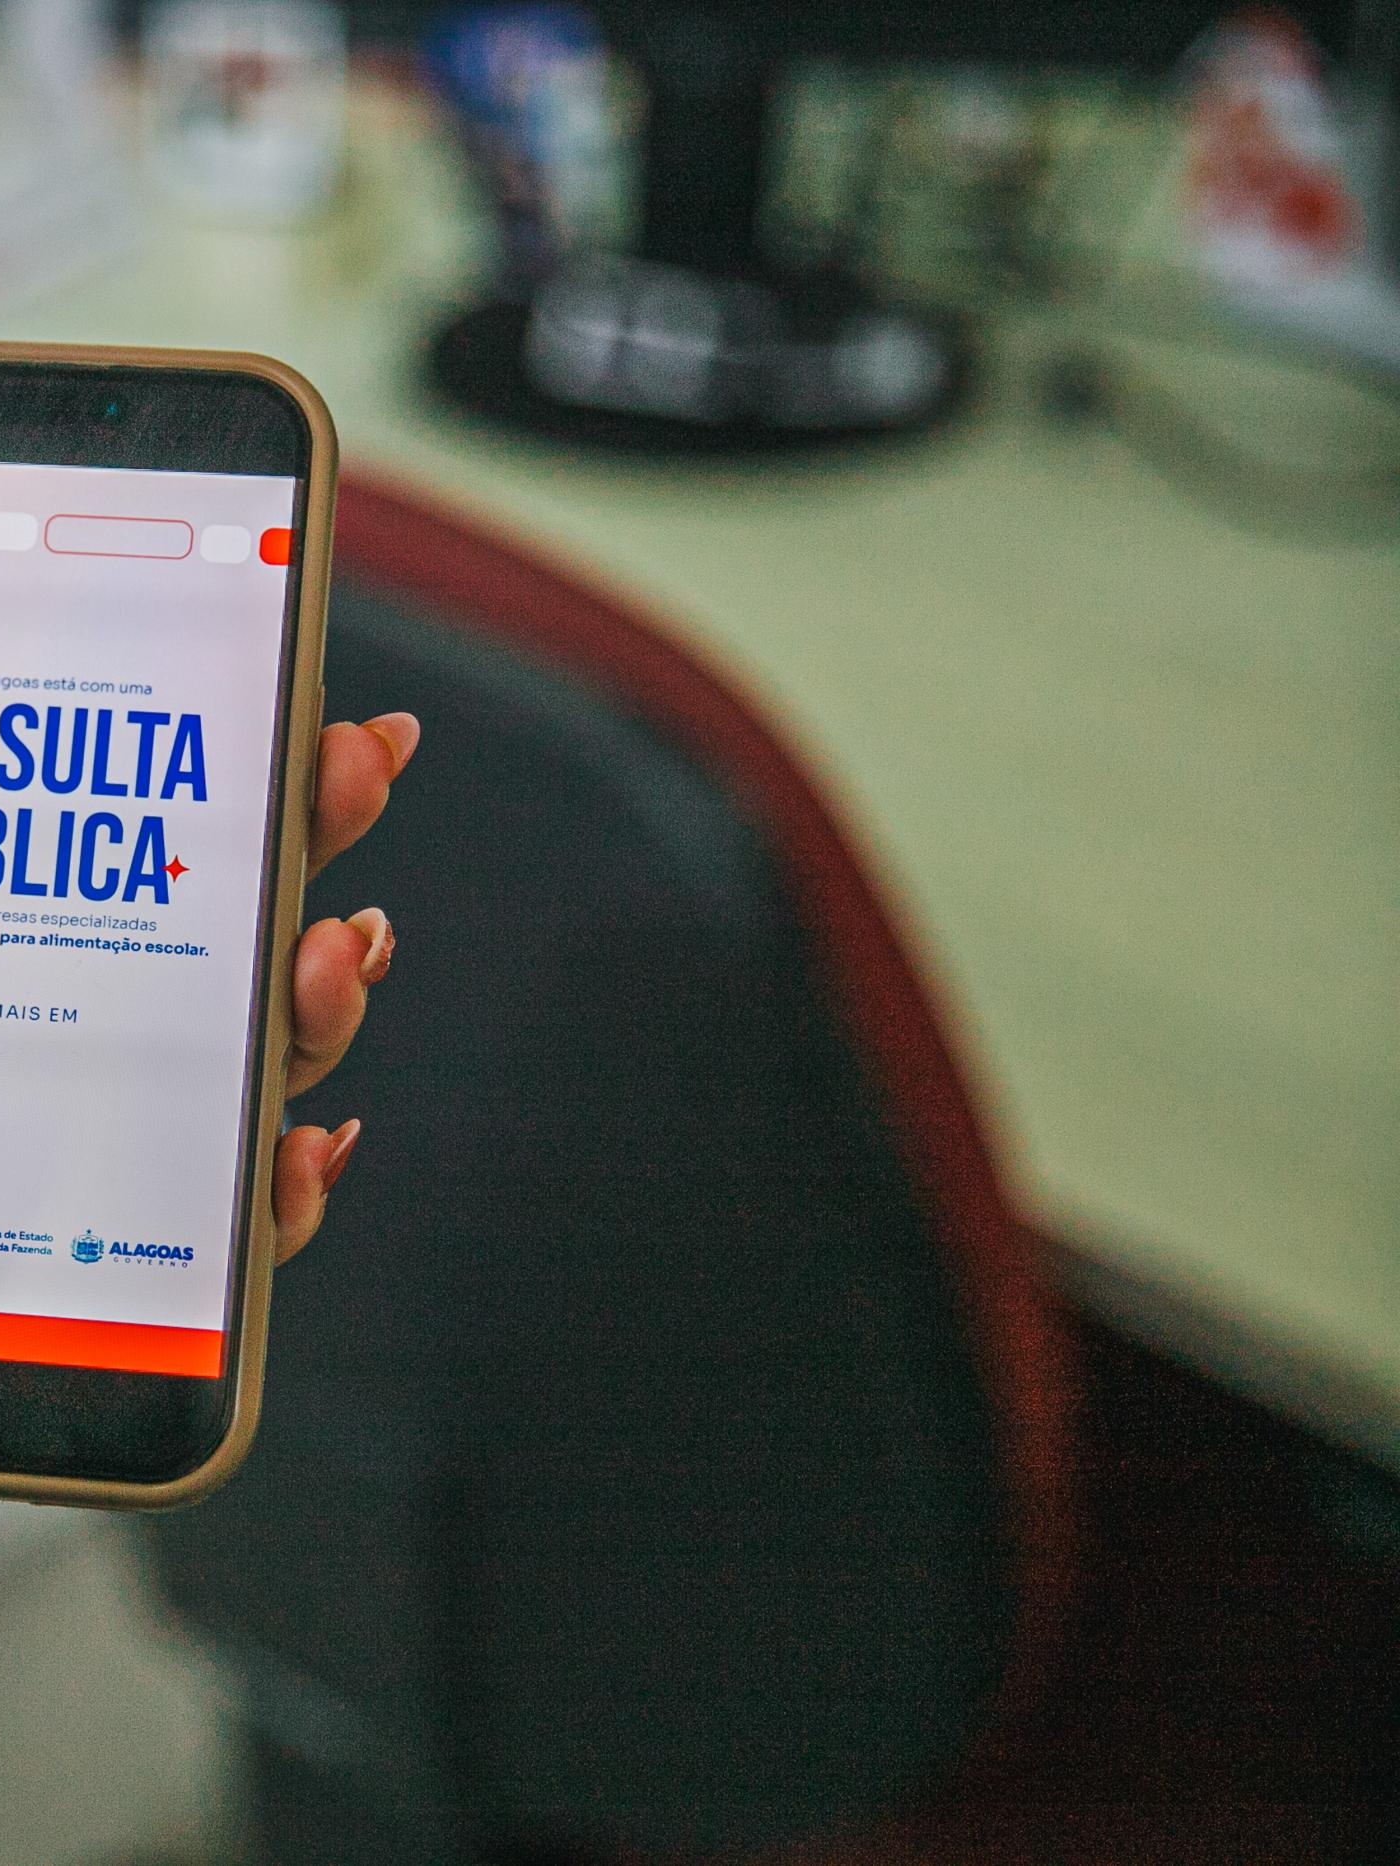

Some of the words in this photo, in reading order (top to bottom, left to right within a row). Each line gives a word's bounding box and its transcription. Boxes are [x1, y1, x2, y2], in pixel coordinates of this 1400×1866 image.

[43, 676, 76, 691] está
[80, 680, 114, 694] com
[119, 682, 152, 696] uma
[40, 913, 157, 932] especializadas
[0, 932, 36, 946] para
[39, 933, 142, 954] alimentação
[145, 941, 209, 957] escolar.
[49, 1007, 78, 1024] EM
[4, 1229, 17, 1241] de
[19, 1231, 54, 1243] Estado
[11, 1243, 53, 1256] Fazenda
[108, 1241, 194, 1262] ALAGOAS
[113, 1256, 188, 1269] GOVERNO
